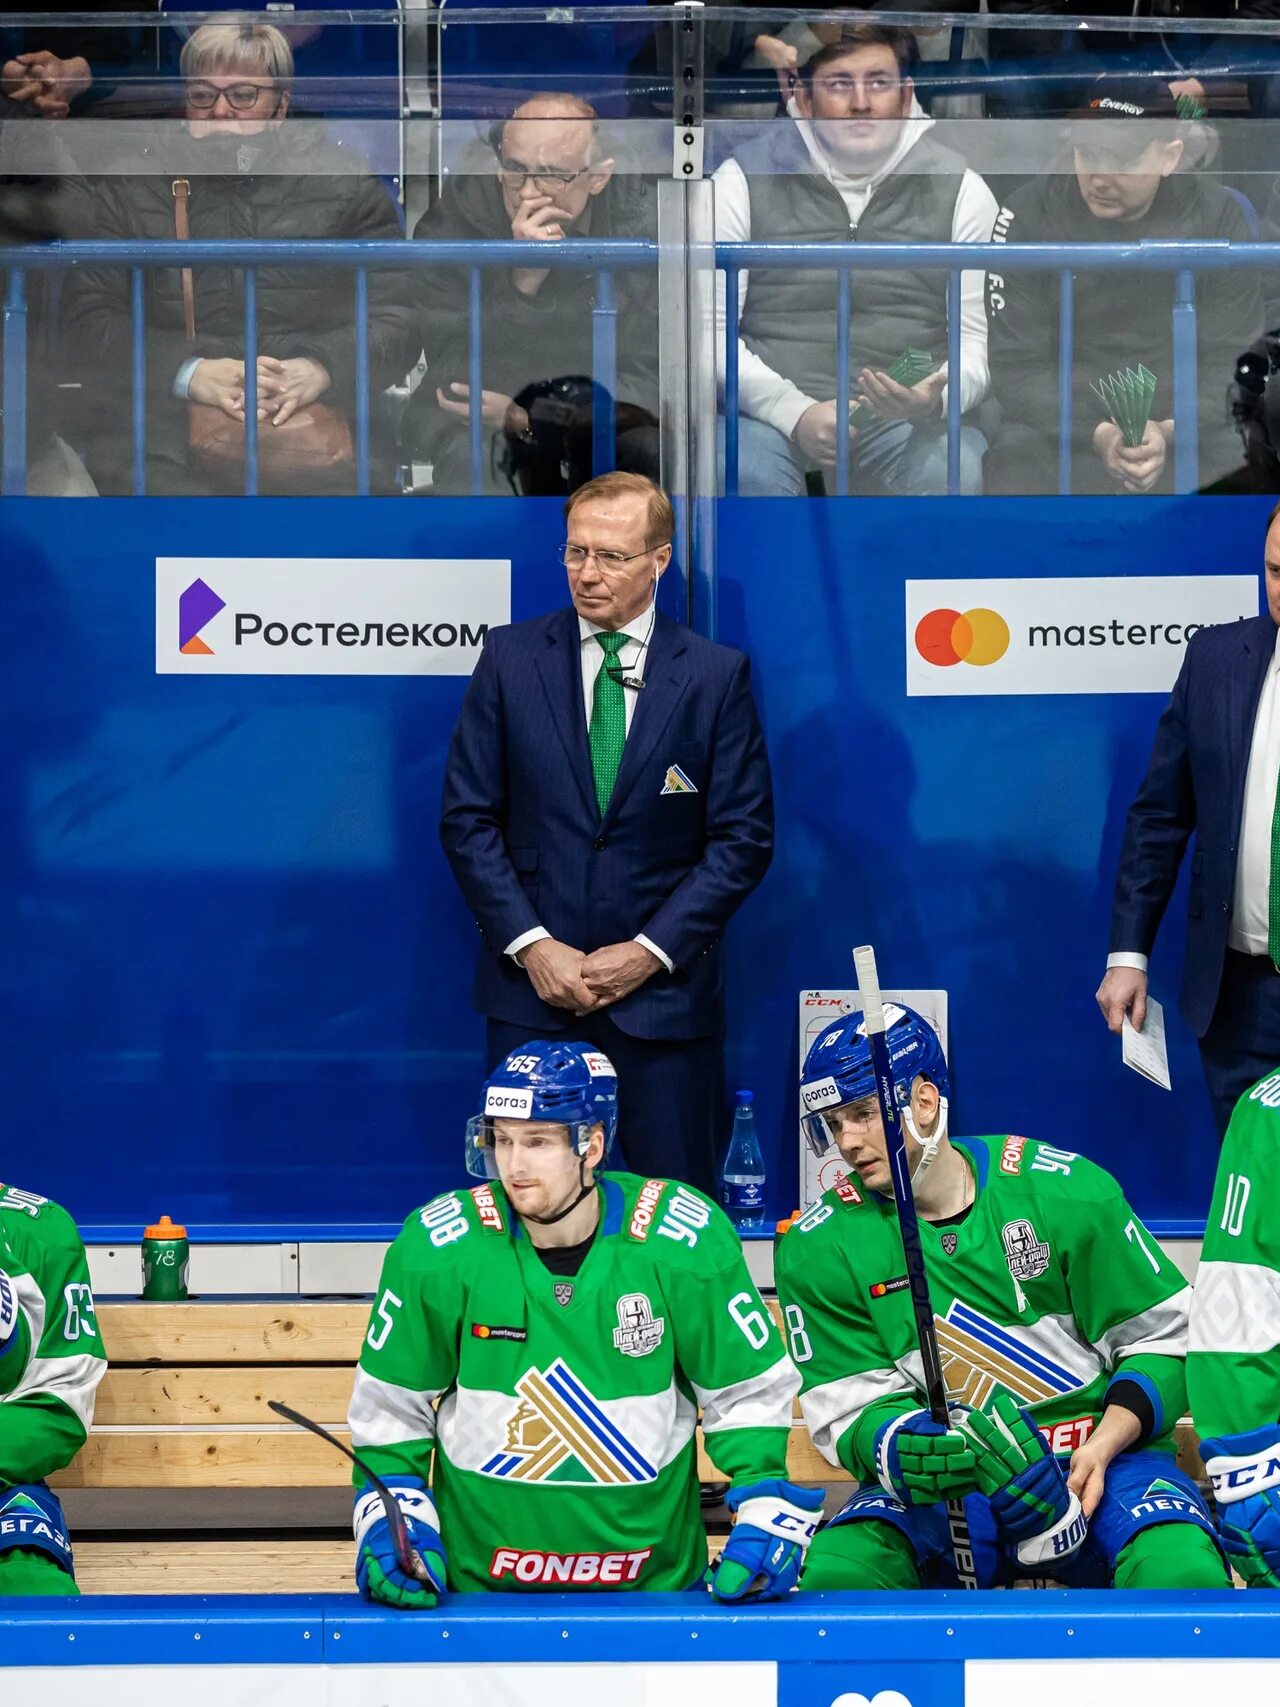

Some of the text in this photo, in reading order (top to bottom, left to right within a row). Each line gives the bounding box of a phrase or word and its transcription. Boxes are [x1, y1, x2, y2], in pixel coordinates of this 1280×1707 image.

[235, 613, 488, 647] Ростелеком
[818, 1029, 844, 1051] 78
[507, 1055, 541, 1074] 65
[488, 1096, 527, 1109] согаз
[805, 1085, 837, 1102] согаз
[1221, 1173, 1251, 1236] 10
[153, 1250, 176, 1267] 78
[1124, 1219, 1161, 1275] 7
[367, 1288, 403, 1350] 5
[491, 1328, 526, 1339] mastercard
[728, 1292, 776, 1350] 6
[785, 1304, 813, 1363] 8
[493, 1550, 651, 1582] FONBET
